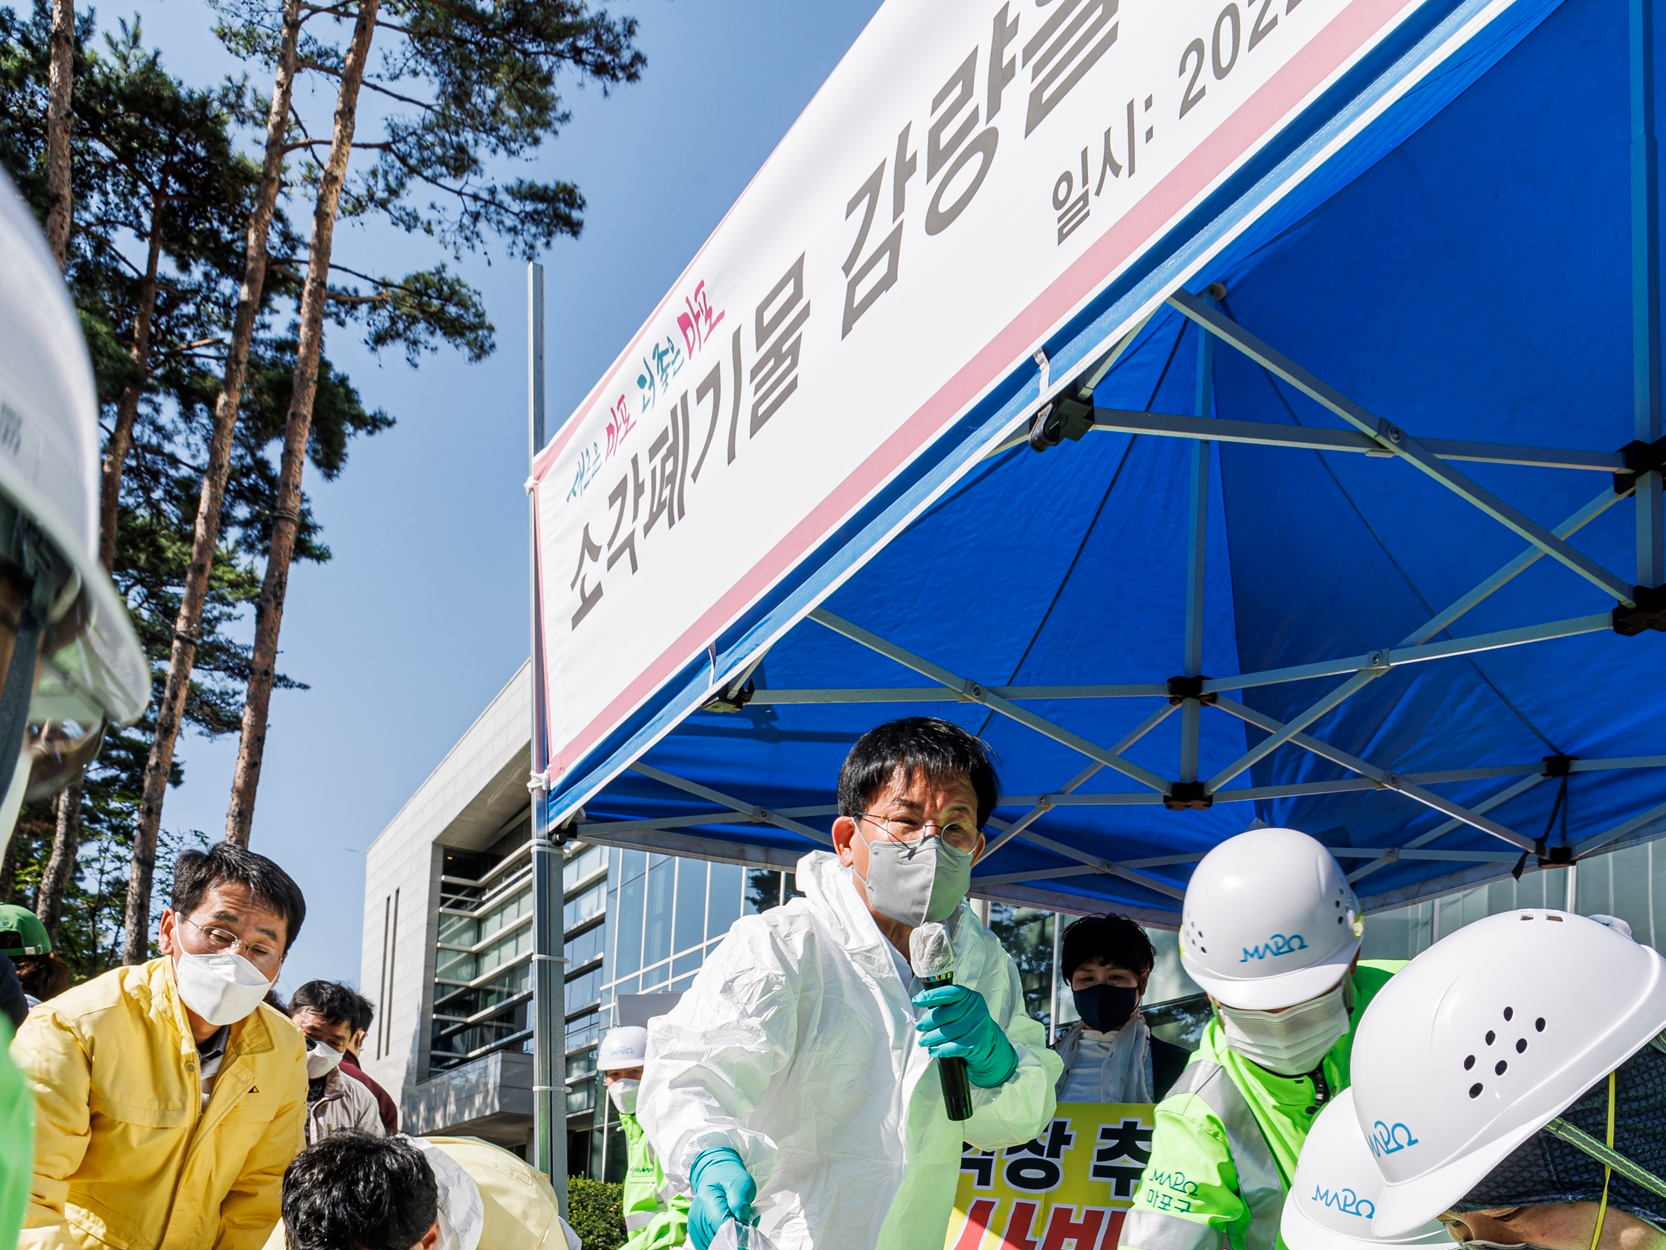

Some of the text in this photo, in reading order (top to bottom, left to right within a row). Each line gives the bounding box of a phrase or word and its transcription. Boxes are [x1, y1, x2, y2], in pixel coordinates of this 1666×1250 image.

[1053, 0, 1301, 247] 일시: 202
[570, 250, 811, 632] 소각폐기물
[605, 394, 637, 462] 마포
[677, 279, 725, 360] 마포
[1147, 1189, 1191, 1213] 마포구
